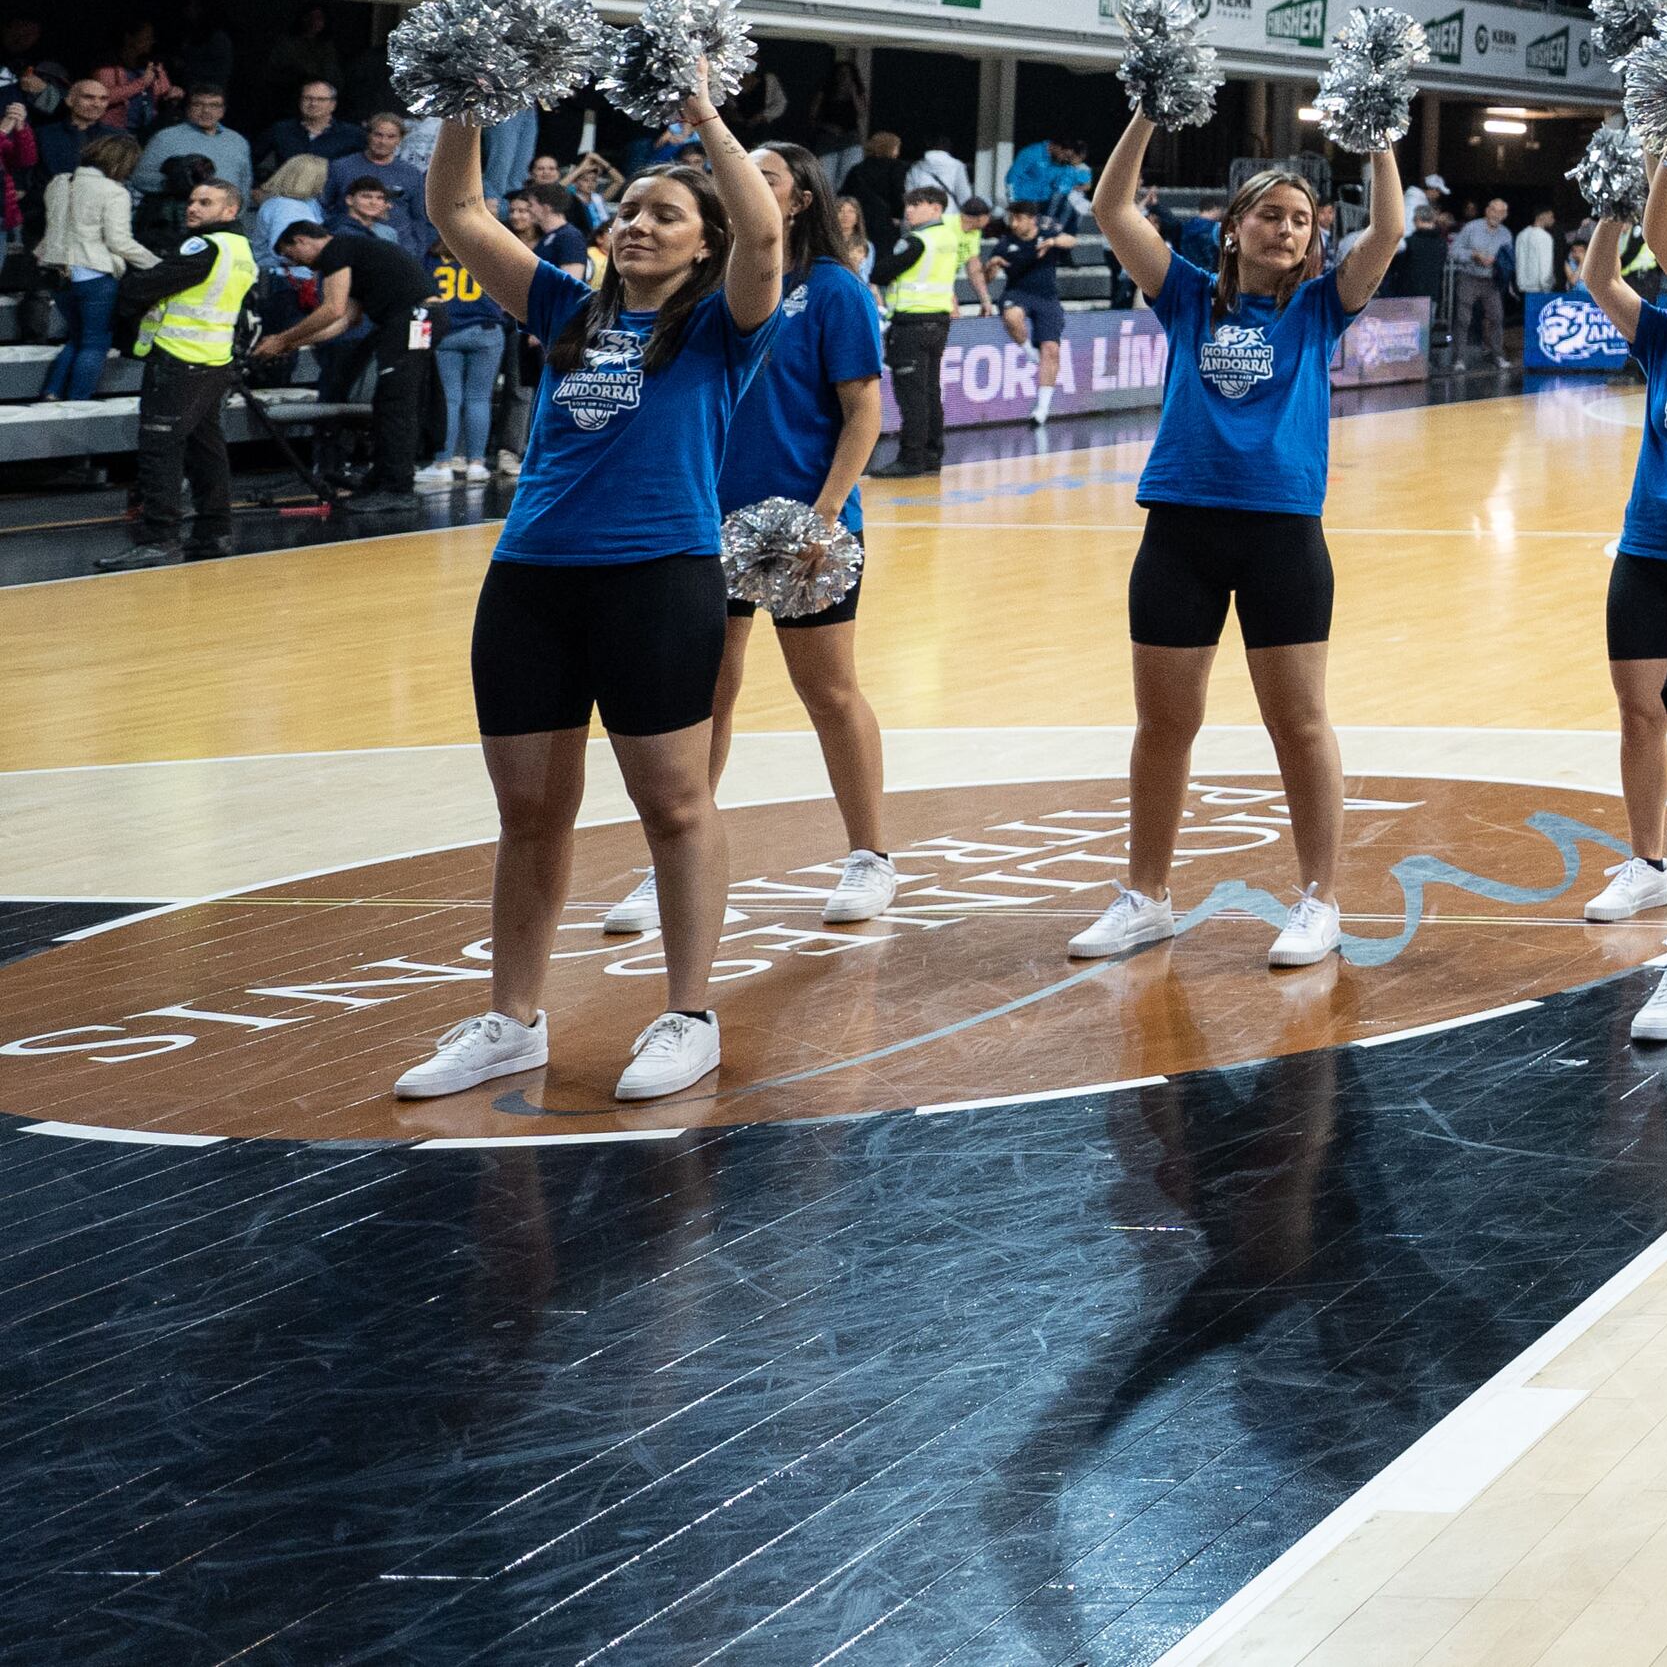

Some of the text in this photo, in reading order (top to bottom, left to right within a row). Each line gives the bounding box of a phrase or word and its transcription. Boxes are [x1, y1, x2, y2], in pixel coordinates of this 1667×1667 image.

[1267, 0, 1324, 40] FINISHER
[433, 267, 482, 302] 30
[1204, 347, 1270, 358] MORABANC
[1203, 357, 1269, 374] ANDORRA
[557, 382, 635, 402] ANDORRA
